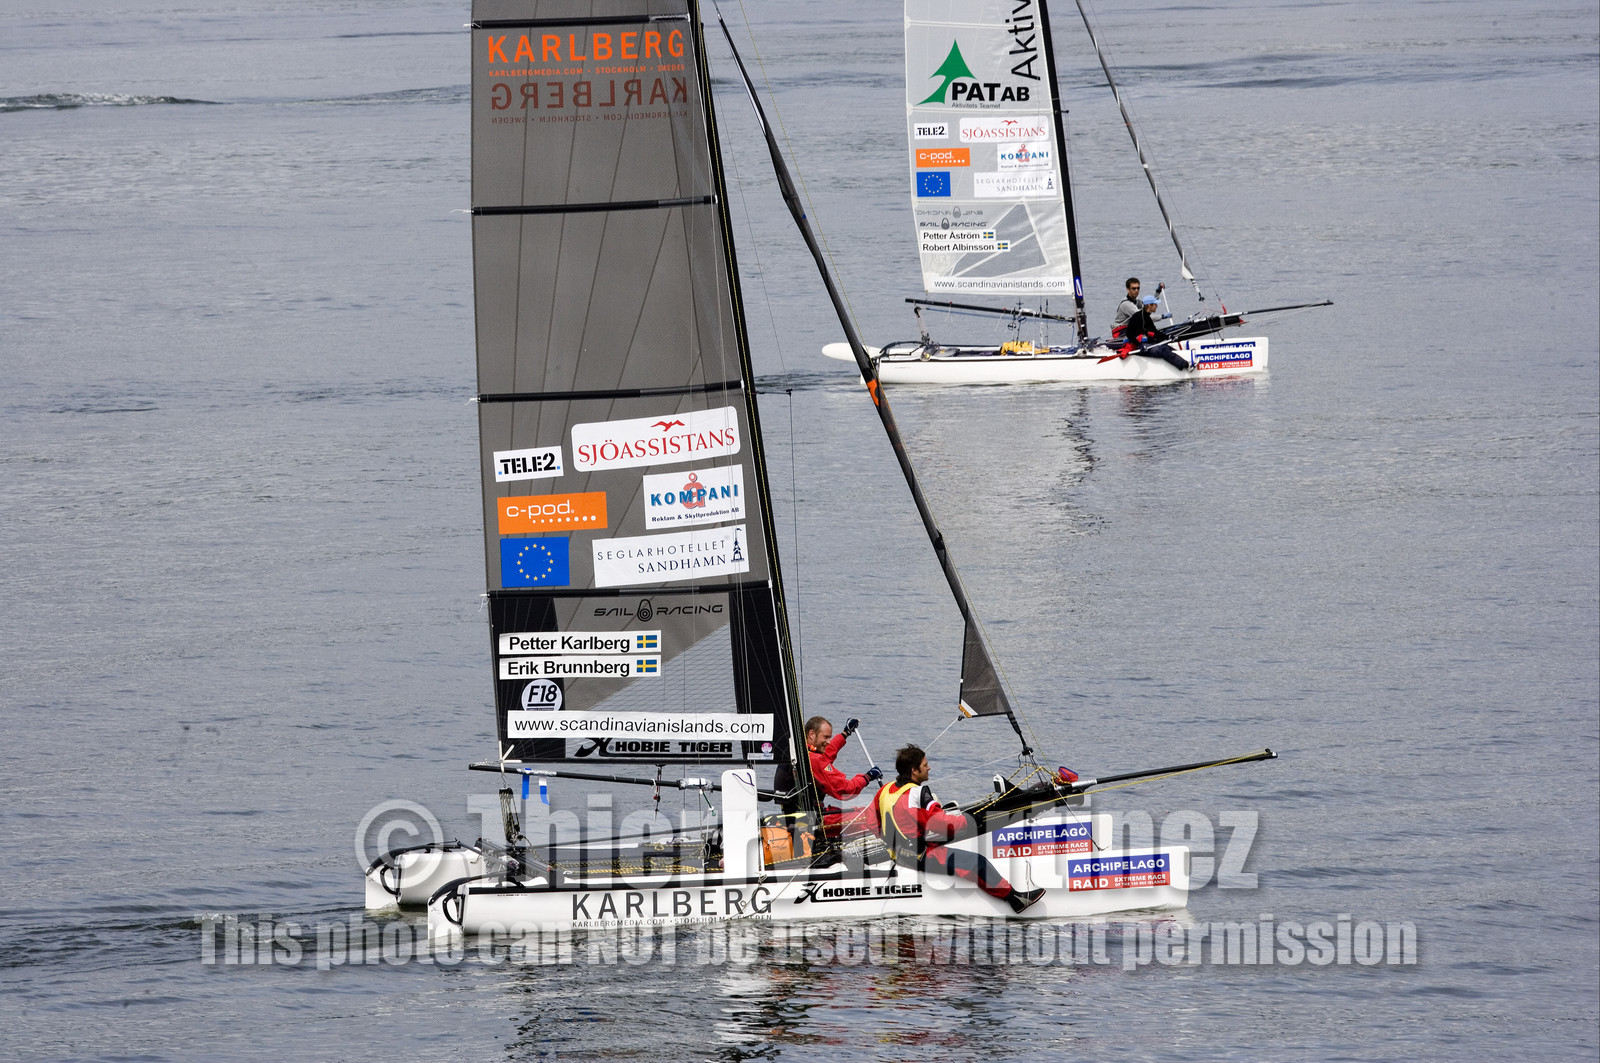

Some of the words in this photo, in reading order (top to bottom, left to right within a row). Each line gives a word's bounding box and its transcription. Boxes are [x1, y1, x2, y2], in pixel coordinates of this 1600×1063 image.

[488, 30, 684, 63] KARLBERG
[489, 68, 583, 77] KARLBERGMEDIA.COM
[595, 66, 646, 74] STOCKHOLM
[962, 126, 1046, 140] SJÖASSISTANS
[1001, 152, 1049, 160] KOMPANI
[923, 232, 947, 240] Petter
[949, 231, 980, 240] Åström
[922, 243, 950, 251] Robert
[952, 243, 995, 251] Albinsson
[934, 280, 1066, 288] www.scandinavianislands.com
[1199, 353, 1250, 361] ARCHIPELAGO
[578, 428, 735, 466] SJÖASSISTANS
[650, 484, 739, 506] KOMPANI
[684, 509, 730, 520] Skyltproduktion
[597, 540, 725, 560] SEGLARHOTELLET
[638, 554, 727, 574] SANDHAMN
[594, 608, 633, 617] SAIL
[656, 604, 723, 616] RACING
[509, 637, 557, 650] Petter
[561, 635, 630, 652] Karlberg
[508, 660, 539, 675] Erik
[543, 659, 630, 677] Brunnberg
[528, 685, 557, 702] F18
[514, 717, 765, 734] www.scandinavianislands.com
[615, 741, 670, 753] HOBIE
[679, 741, 732, 753] TIGER
[997, 827, 1087, 842] ARCHIPELAGO
[997, 846, 1032, 858] RAID
[1037, 843, 1069, 851] EXTREME
[1073, 859, 1165, 873] ARCHIPELAGO
[1073, 878, 1109, 889] RAID
[822, 887, 870, 897] HOBIE
[875, 884, 923, 895] TIGER
[572, 886, 771, 920] KARLBERG
[572, 919, 665, 928] KARLBERGMEDIA.COM
